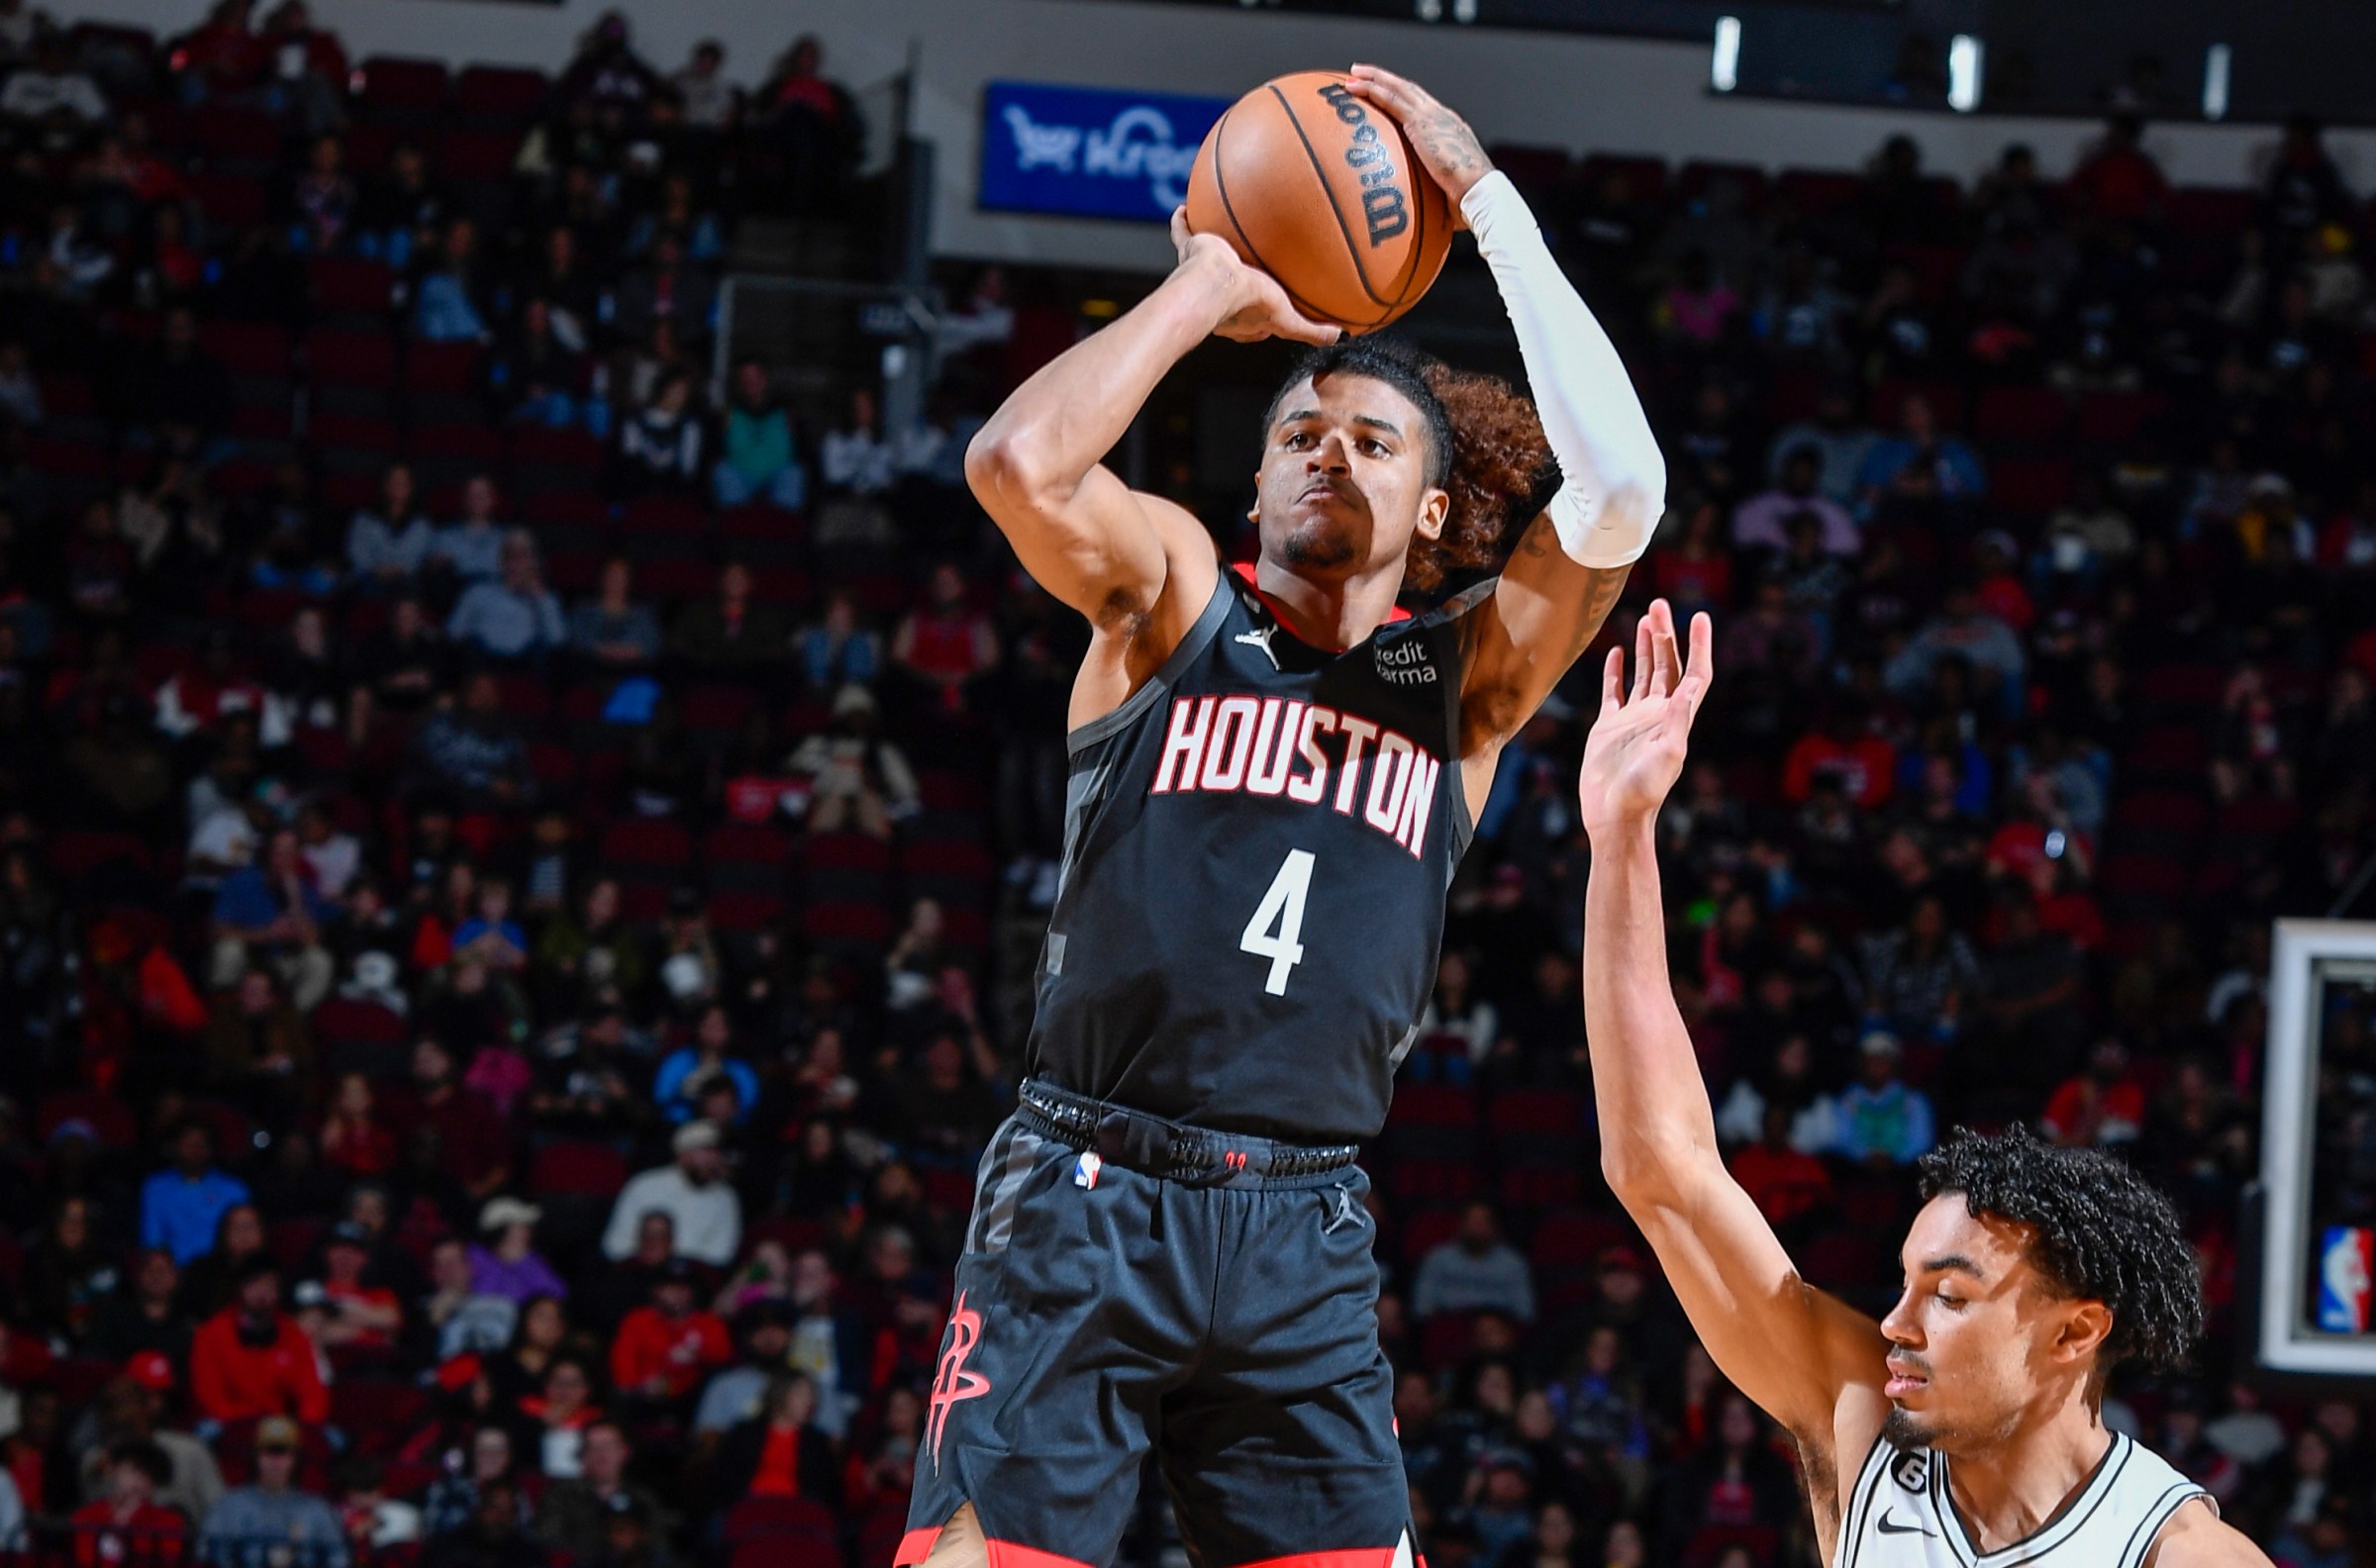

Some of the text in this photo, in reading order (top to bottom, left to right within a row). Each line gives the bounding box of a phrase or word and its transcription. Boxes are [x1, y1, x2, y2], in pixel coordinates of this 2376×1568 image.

[1317, 83, 1409, 248] Wilson
[1151, 695, 1440, 860] HOUSTON
[1239, 848, 1316, 997] 4
[1898, 1457, 1926, 1491] 6
